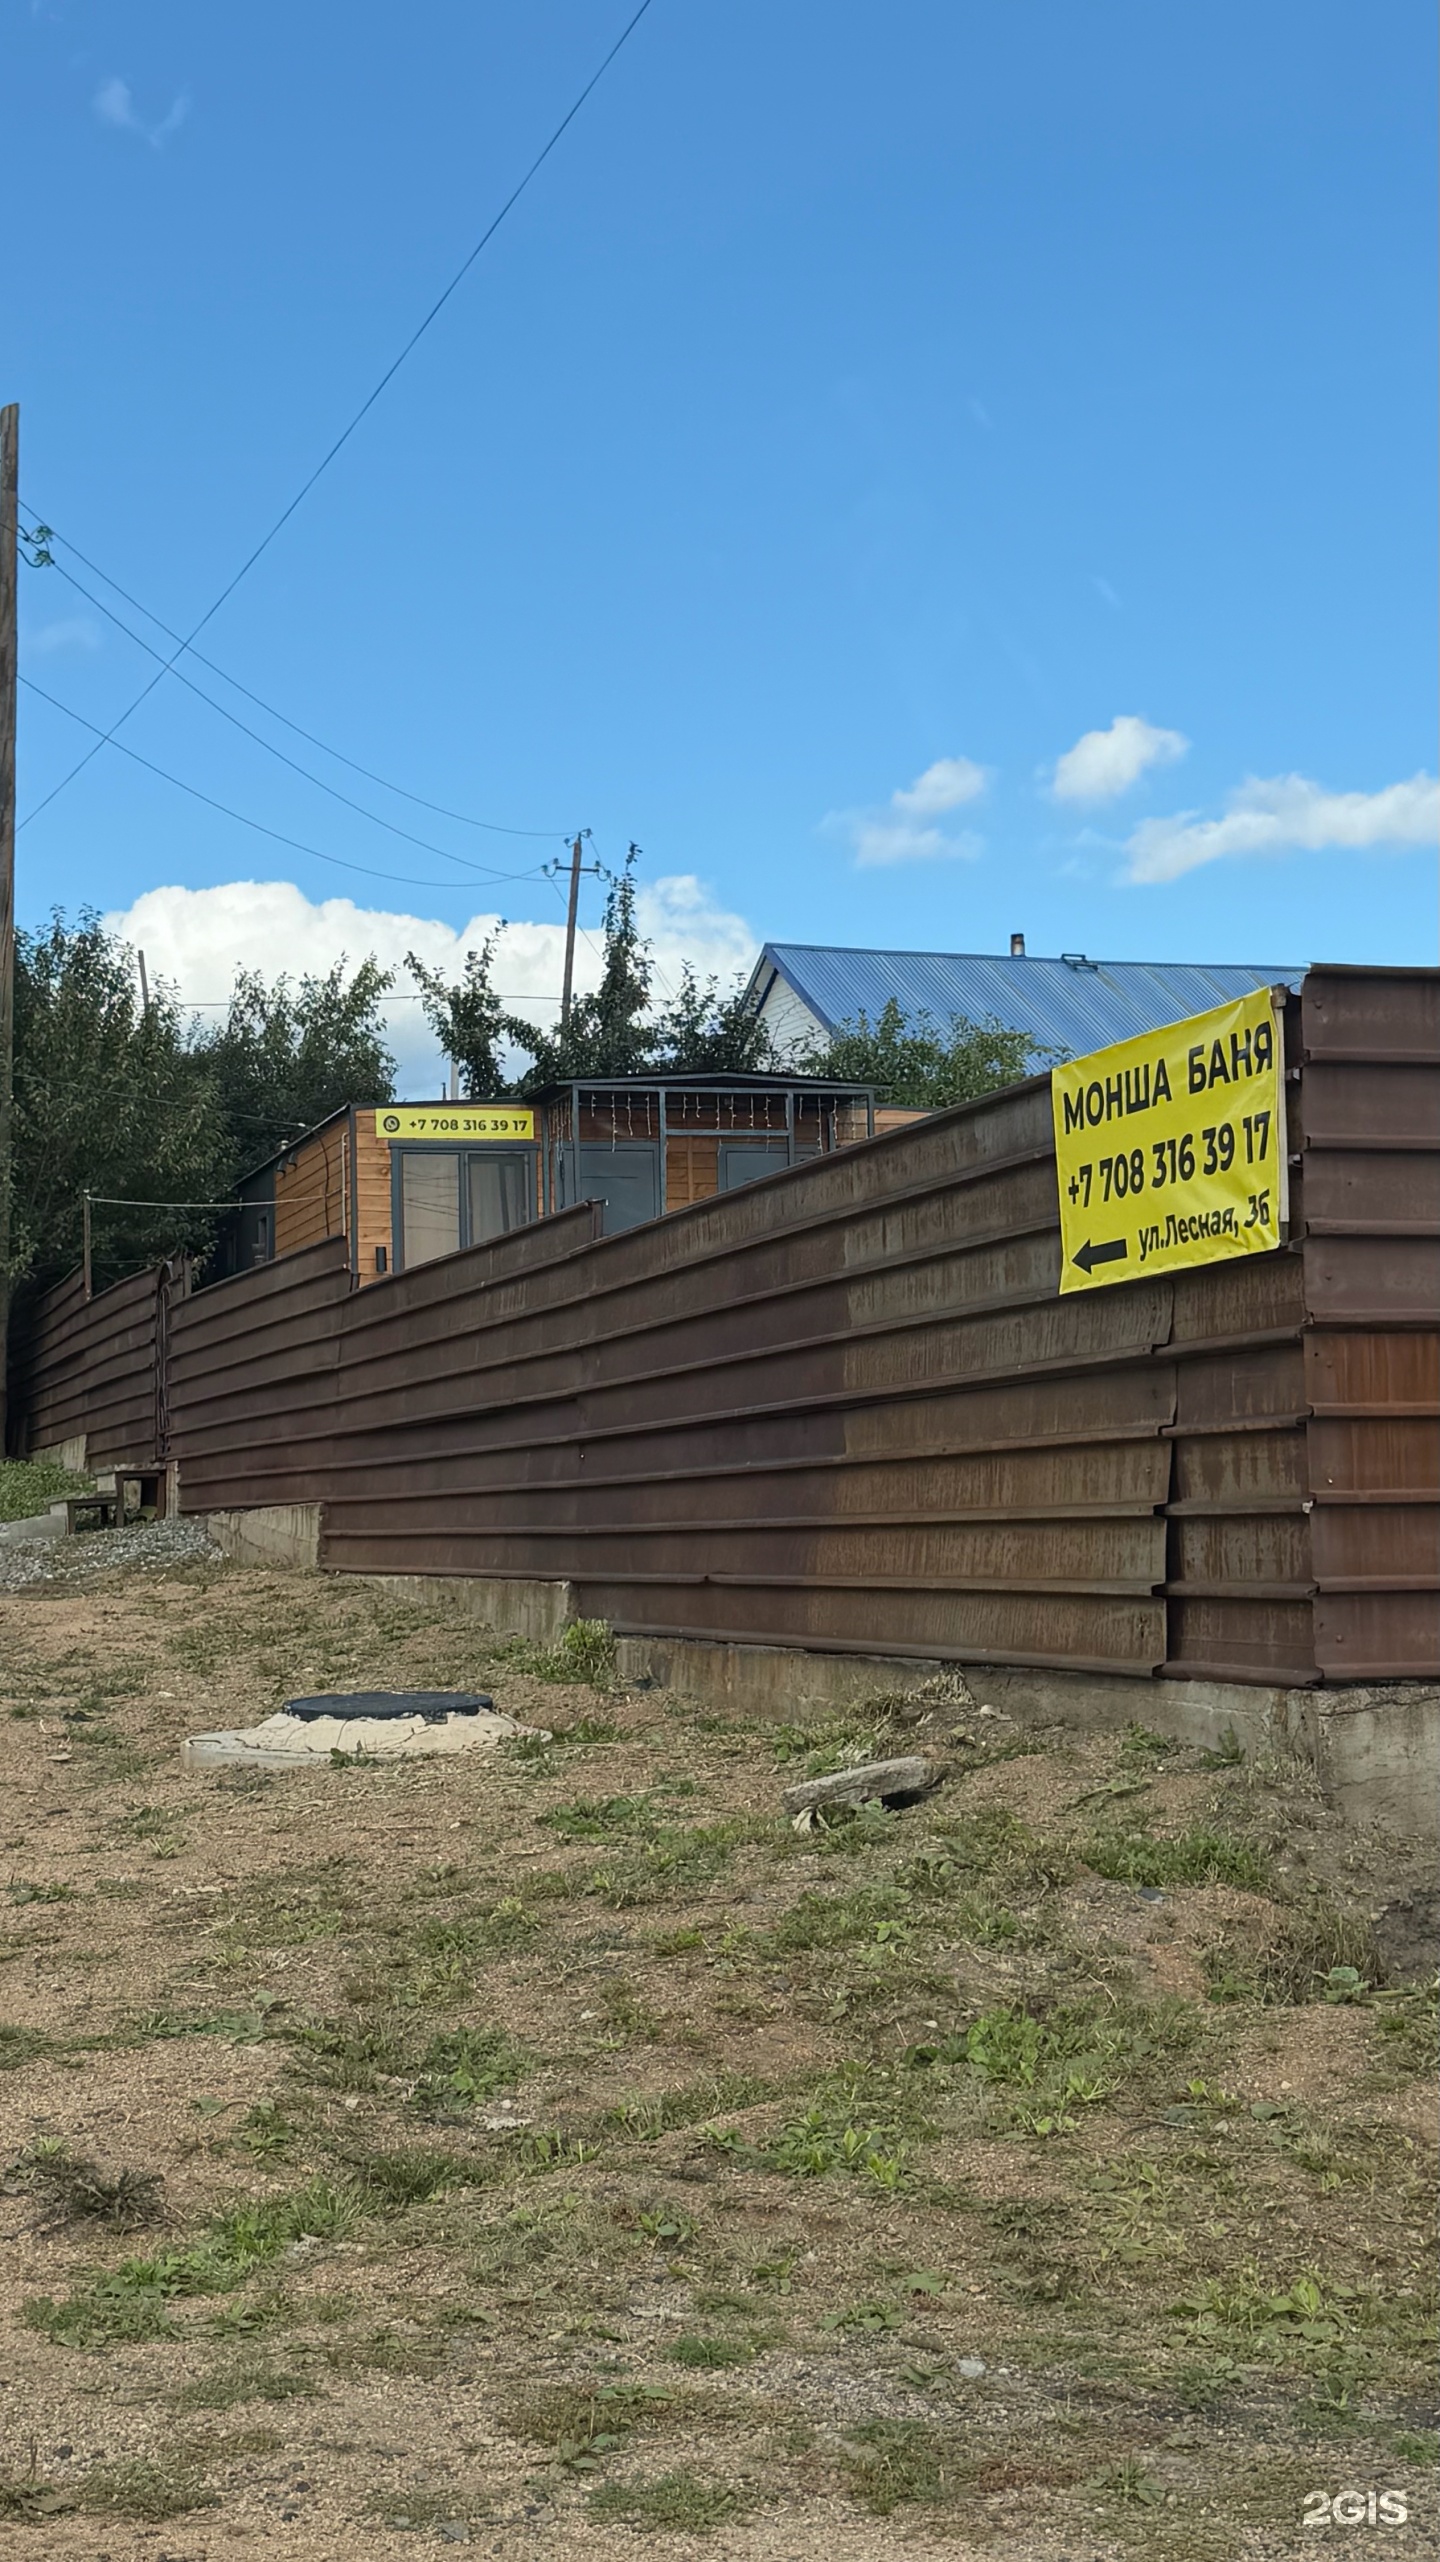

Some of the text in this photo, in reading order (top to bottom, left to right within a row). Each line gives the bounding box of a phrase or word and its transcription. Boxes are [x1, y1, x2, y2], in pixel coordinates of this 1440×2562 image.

[1063, 1021, 1273, 1135] МОНША БАНЯ
[409, 1119, 528, 1132] +7 708 316 39 17
[1068, 1110, 1271, 1208] +7 708 316 39 17
[1138, 1207, 1240, 1262] ул.Лесная,
